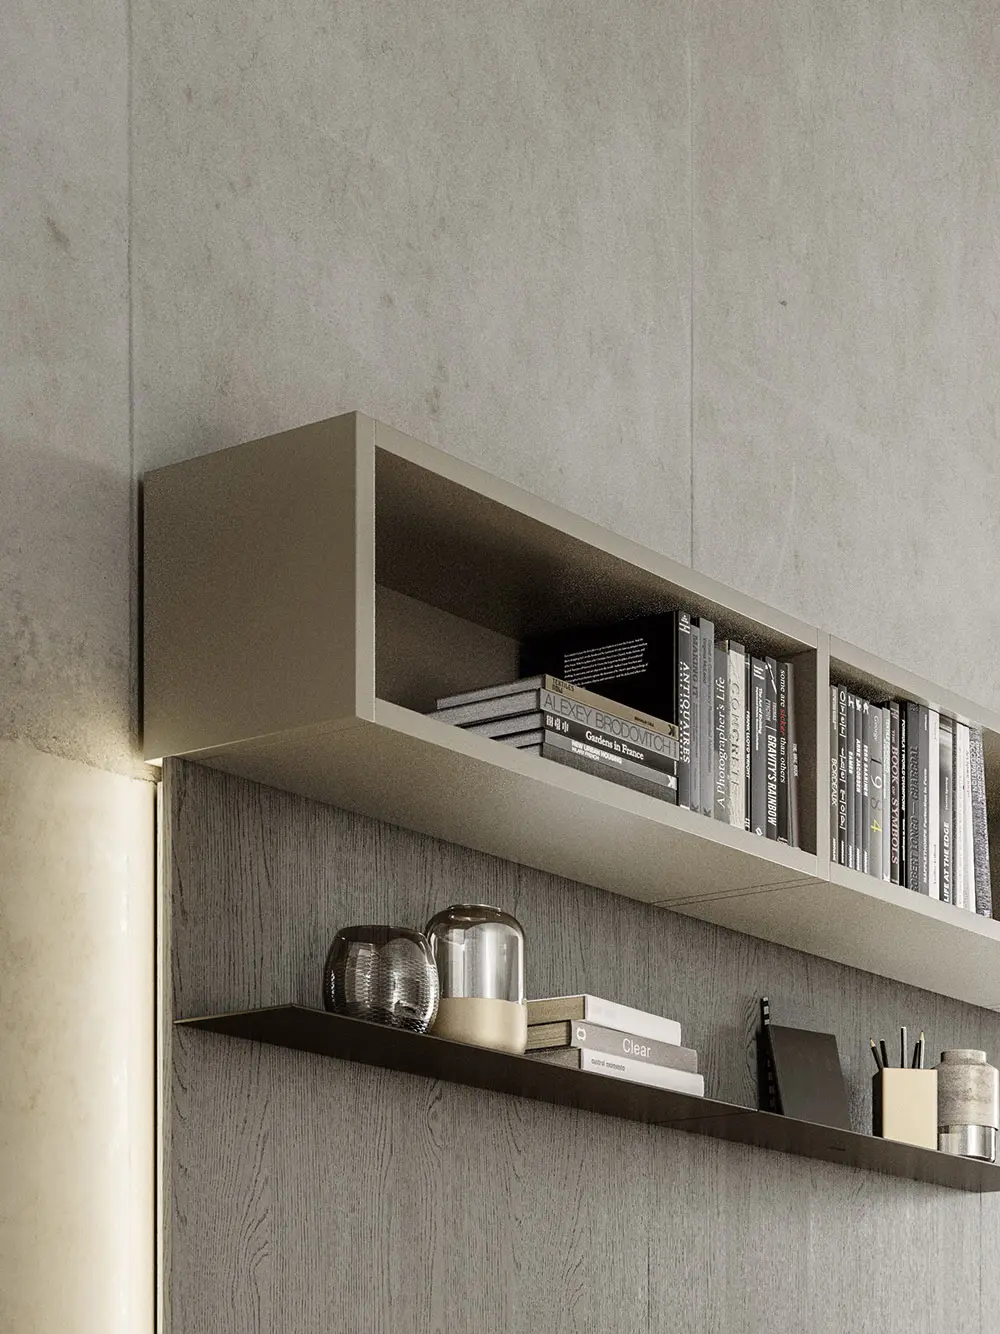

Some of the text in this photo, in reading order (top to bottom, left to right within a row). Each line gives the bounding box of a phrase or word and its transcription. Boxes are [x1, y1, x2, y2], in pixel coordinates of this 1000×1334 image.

[544, 693, 592, 724] ALEXEY
[595, 712, 671, 753] BRODOVITCH
[585, 730, 645, 760] Gardens in France
[600, 750, 622, 764] HOUSING
[716, 677, 727, 808] A Photographer's Life
[767, 734, 777, 827] GRAVITY'S RAINBOW
[871, 775, 882, 789] 9
[891, 746, 899, 784] BOOK
[871, 819, 882, 832] 4
[891, 798, 899, 865] SYMBOLS
[910, 746, 919, 892] ROBERT LONGO CHARCOAL
[943, 868, 950, 882] AT
[622, 1038, 651, 1058] Clear
